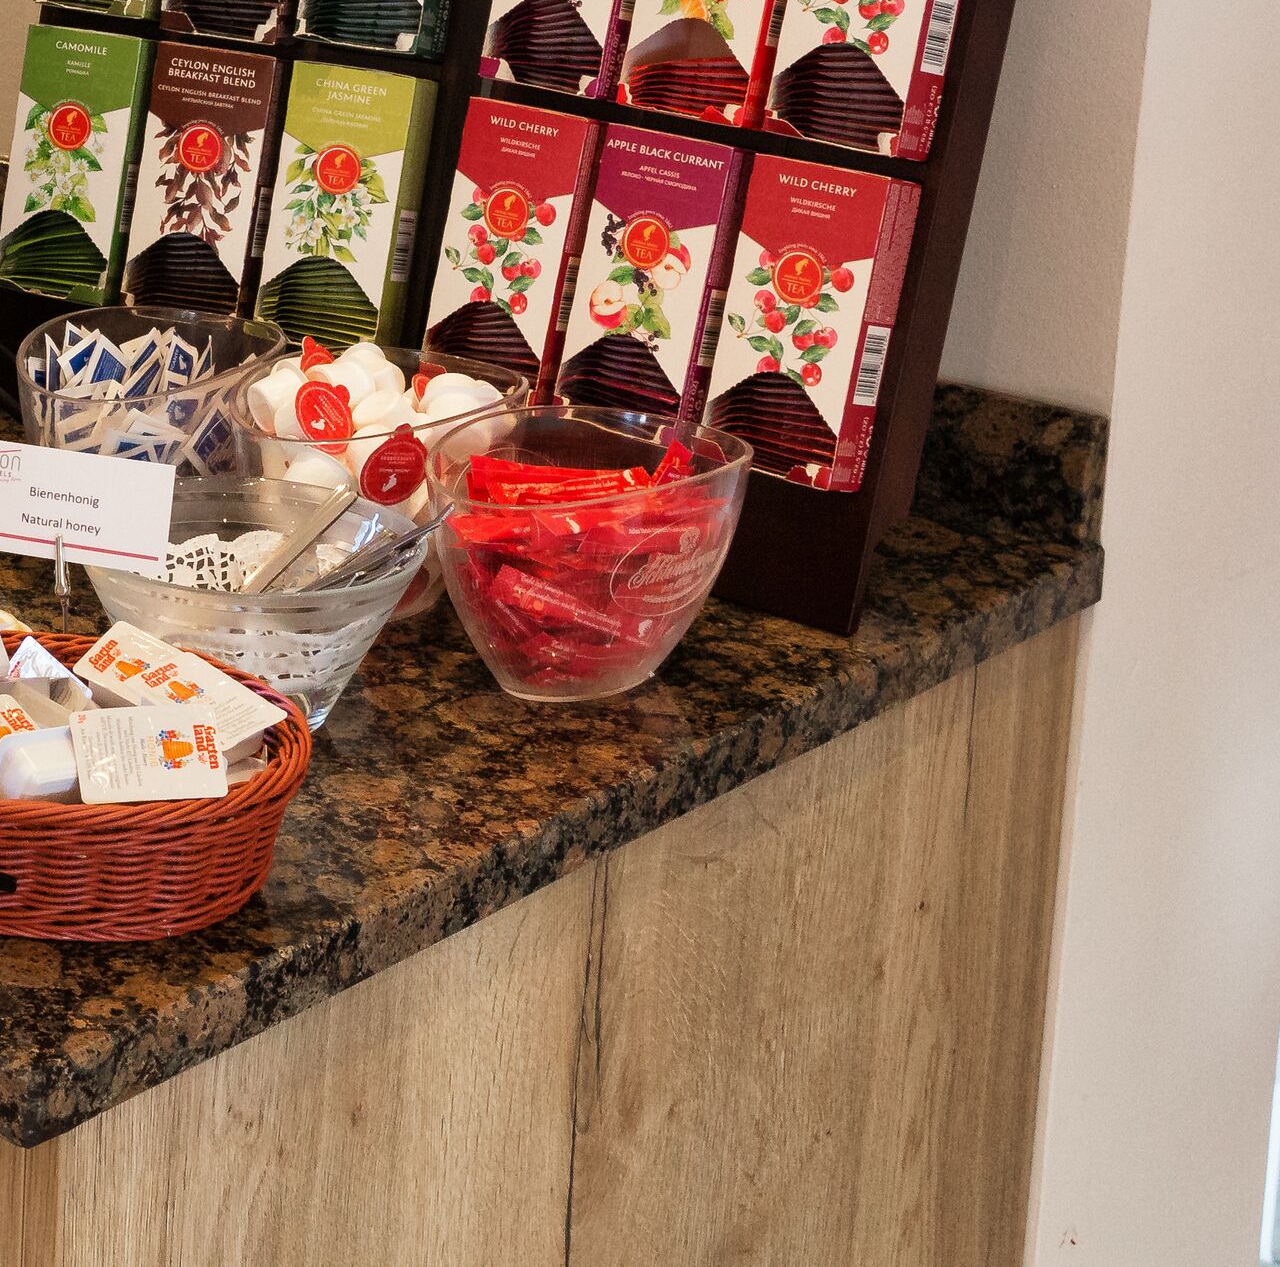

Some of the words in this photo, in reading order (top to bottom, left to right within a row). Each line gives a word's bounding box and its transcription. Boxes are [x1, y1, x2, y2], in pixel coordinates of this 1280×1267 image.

[56, 41, 108, 55] CAMOMILE
[67, 60, 91, 68] KAMILLE
[171, 58, 209, 71] CEYLON
[213, 64, 255, 78] ENGLISH
[168, 68, 220, 84] BREAKFAST
[224, 76, 255, 88] BLEND
[316, 78, 349, 91] CHINA
[353, 84, 387, 96] GREEN
[158, 85, 180, 94] CEYLON
[182, 87, 207, 97] ENGLISH
[208, 91, 239, 102] BREAKFAST
[241, 96, 261, 105] BLEND
[326, 91, 371, 105] JASMINE
[490, 115, 516, 130] WILD
[519, 122, 559, 137] CHERRY
[61, 133, 76, 142] TEA
[500, 137, 541, 150] WILDKIRSCHE
[190, 155, 206, 164] TEA
[608, 138, 637, 153] APPLE
[640, 145, 670, 160] BLACK
[673, 151, 724, 170] CURRANT
[328, 175, 345, 184] TEA
[639, 165, 657, 174] APFEL
[659, 169, 680, 178] CASSIS
[779, 174, 808, 188] WILD
[811, 181, 857, 197] CHERRY
[790, 196, 837, 212] WILDKIRSCHE
[496, 218, 513, 229] TEA
[636, 248, 653, 260] TEA
[787, 284, 805, 294] TEA
[29, 486, 99, 508] Bienenhonig
[21, 513, 62, 529] Natural
[66, 519, 101, 536] honey
[89, 639, 118, 667] Garten
[94, 653, 116, 673] land
[141, 662, 177, 681] Garten
[144, 673, 170, 688] land
[193, 724, 208, 752] land
[205, 726, 219, 769] Garten
